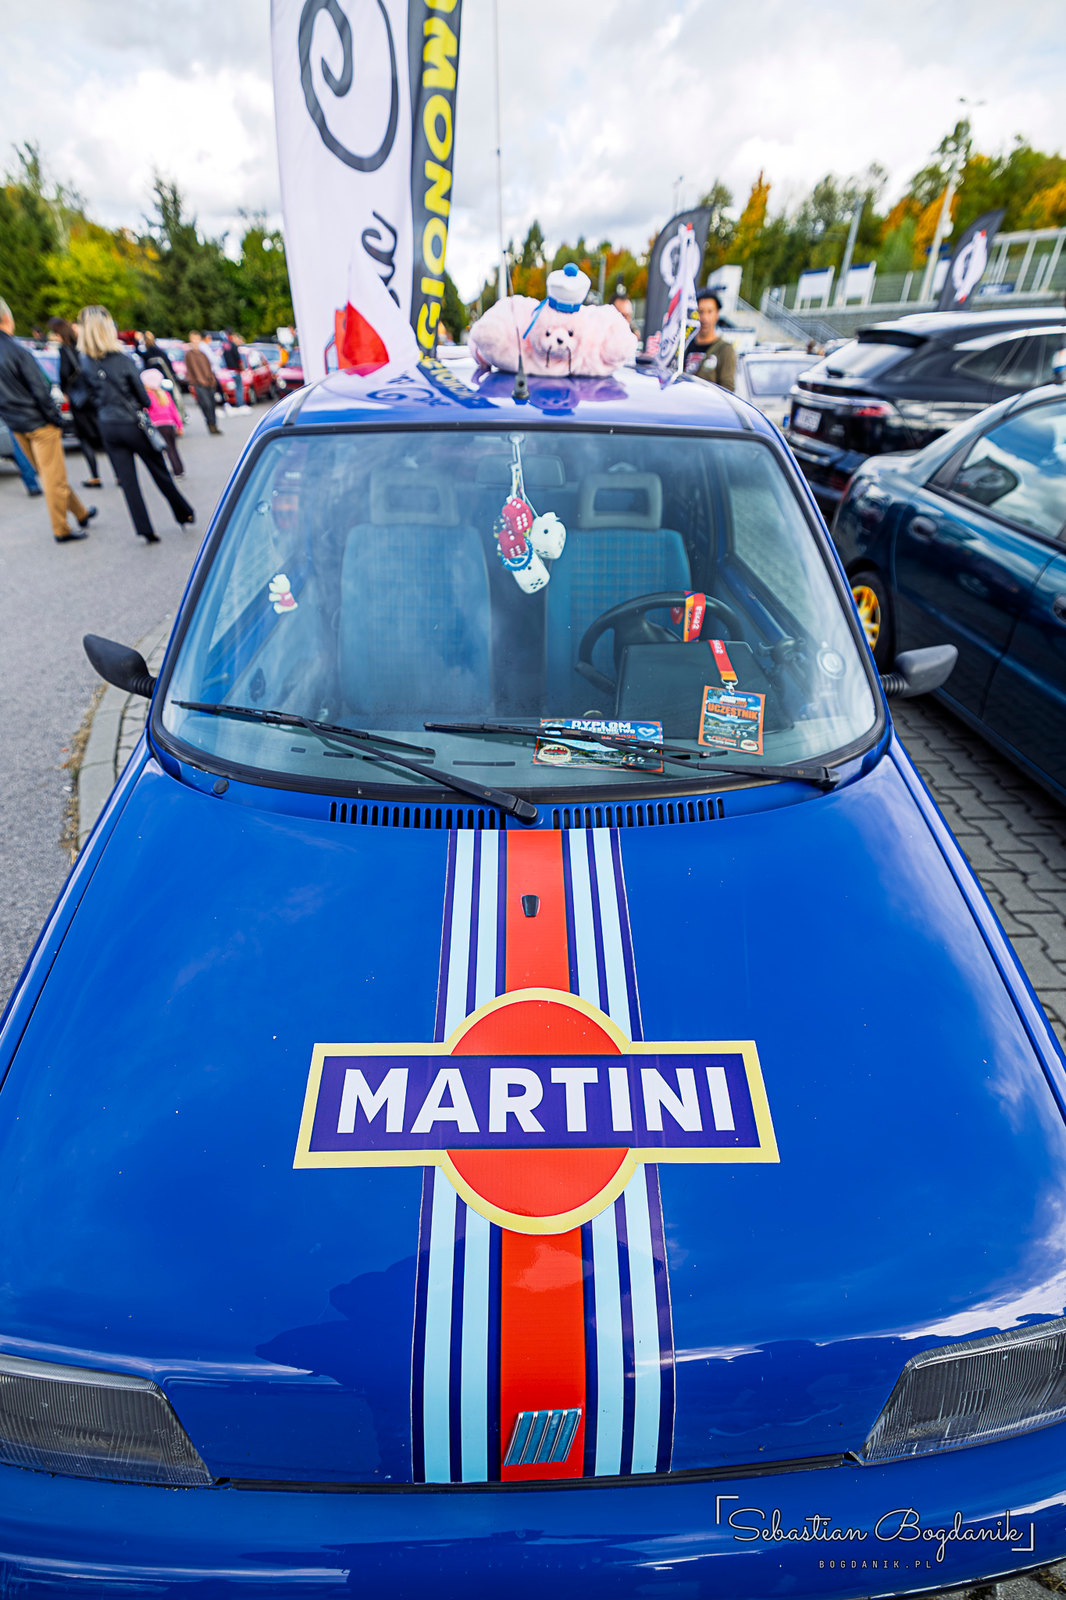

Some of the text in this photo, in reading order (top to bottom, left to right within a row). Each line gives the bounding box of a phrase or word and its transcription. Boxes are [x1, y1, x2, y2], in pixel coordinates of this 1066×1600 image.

[416, 0, 459, 358] GIONOW
[707, 702, 759, 721] UCZESTNIK
[336, 1066, 735, 1133] MARTINI
